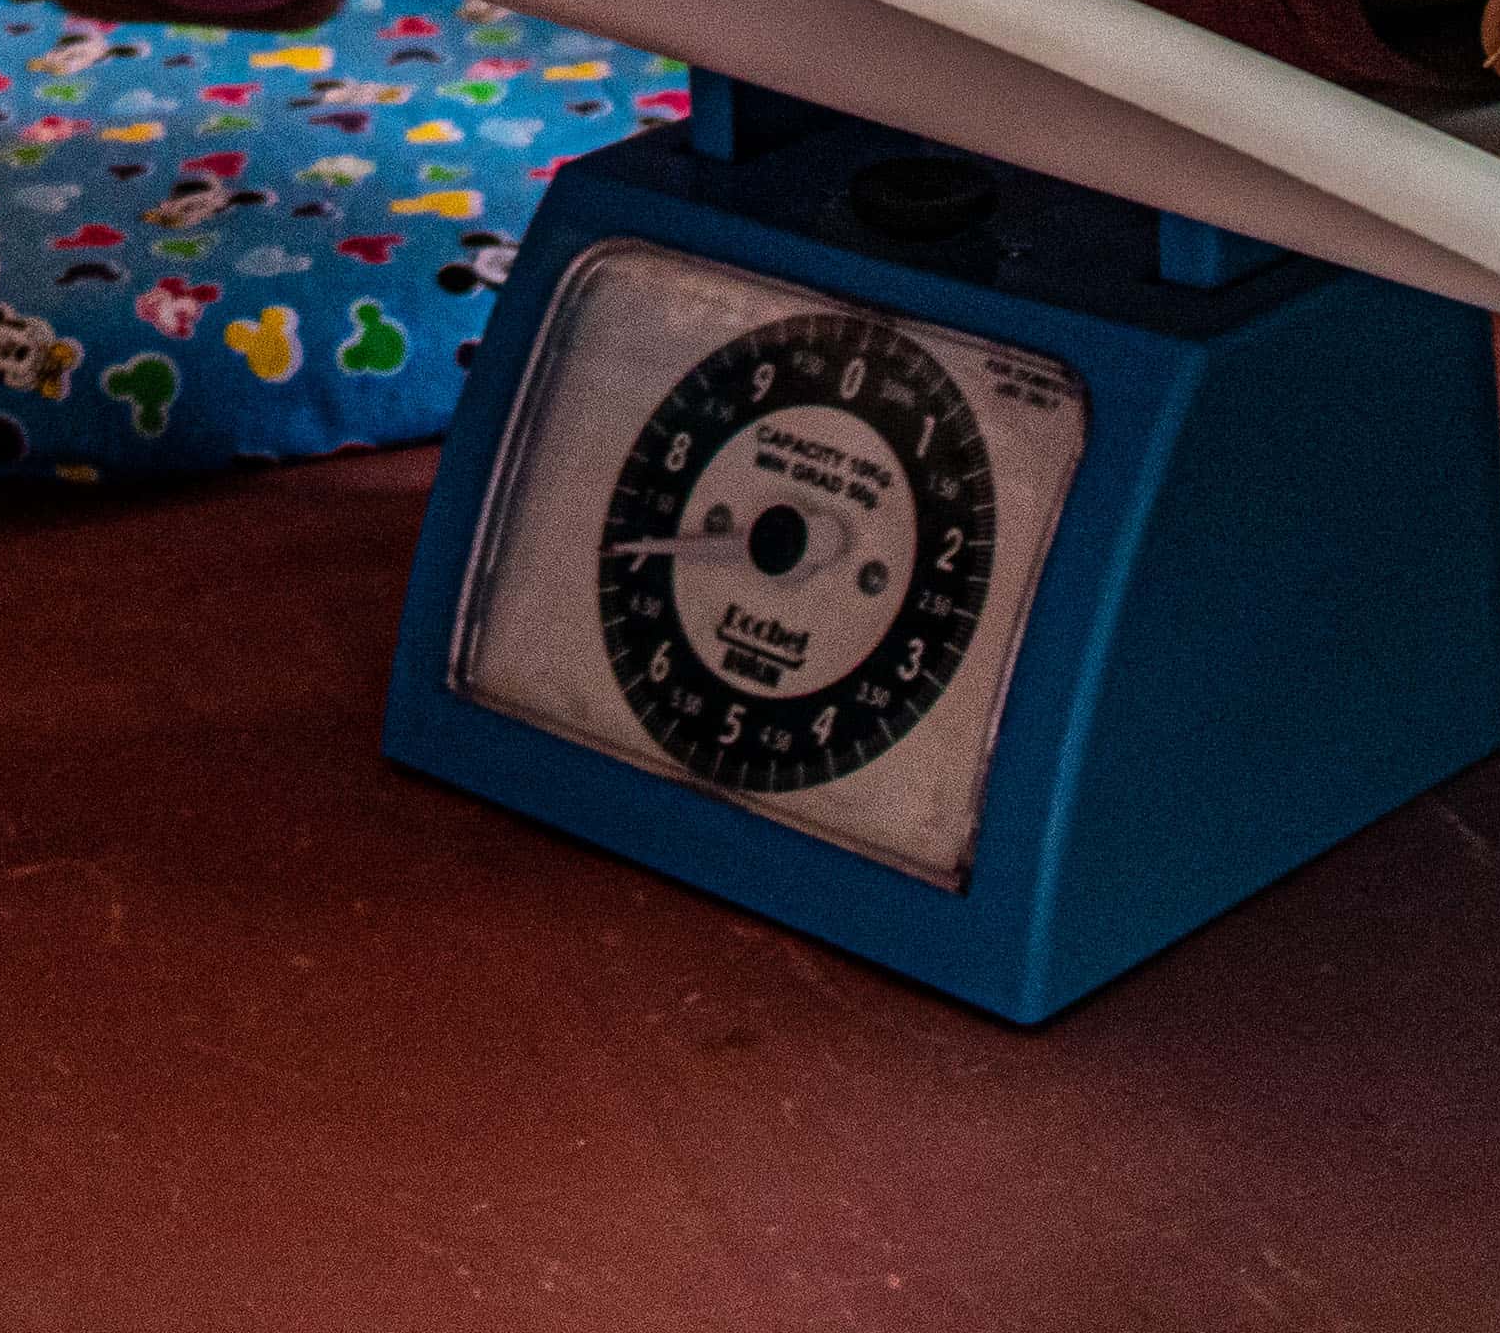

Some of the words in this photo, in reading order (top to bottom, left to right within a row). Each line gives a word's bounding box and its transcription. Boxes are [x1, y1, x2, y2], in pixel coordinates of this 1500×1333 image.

[750, 361, 777, 403] 9
[839, 357, 866, 402] 0
[663, 431, 694, 473] 8
[754, 423, 848, 469] CAPACITY
[916, 414, 936, 458] 1
[790, 464, 843, 496] GRAD
[935, 527, 966, 572] 2
[649, 639, 673, 683] 6
[897, 637, 926, 682] 3
[717, 703, 748, 746] 5
[810, 705, 840, 747] 4
